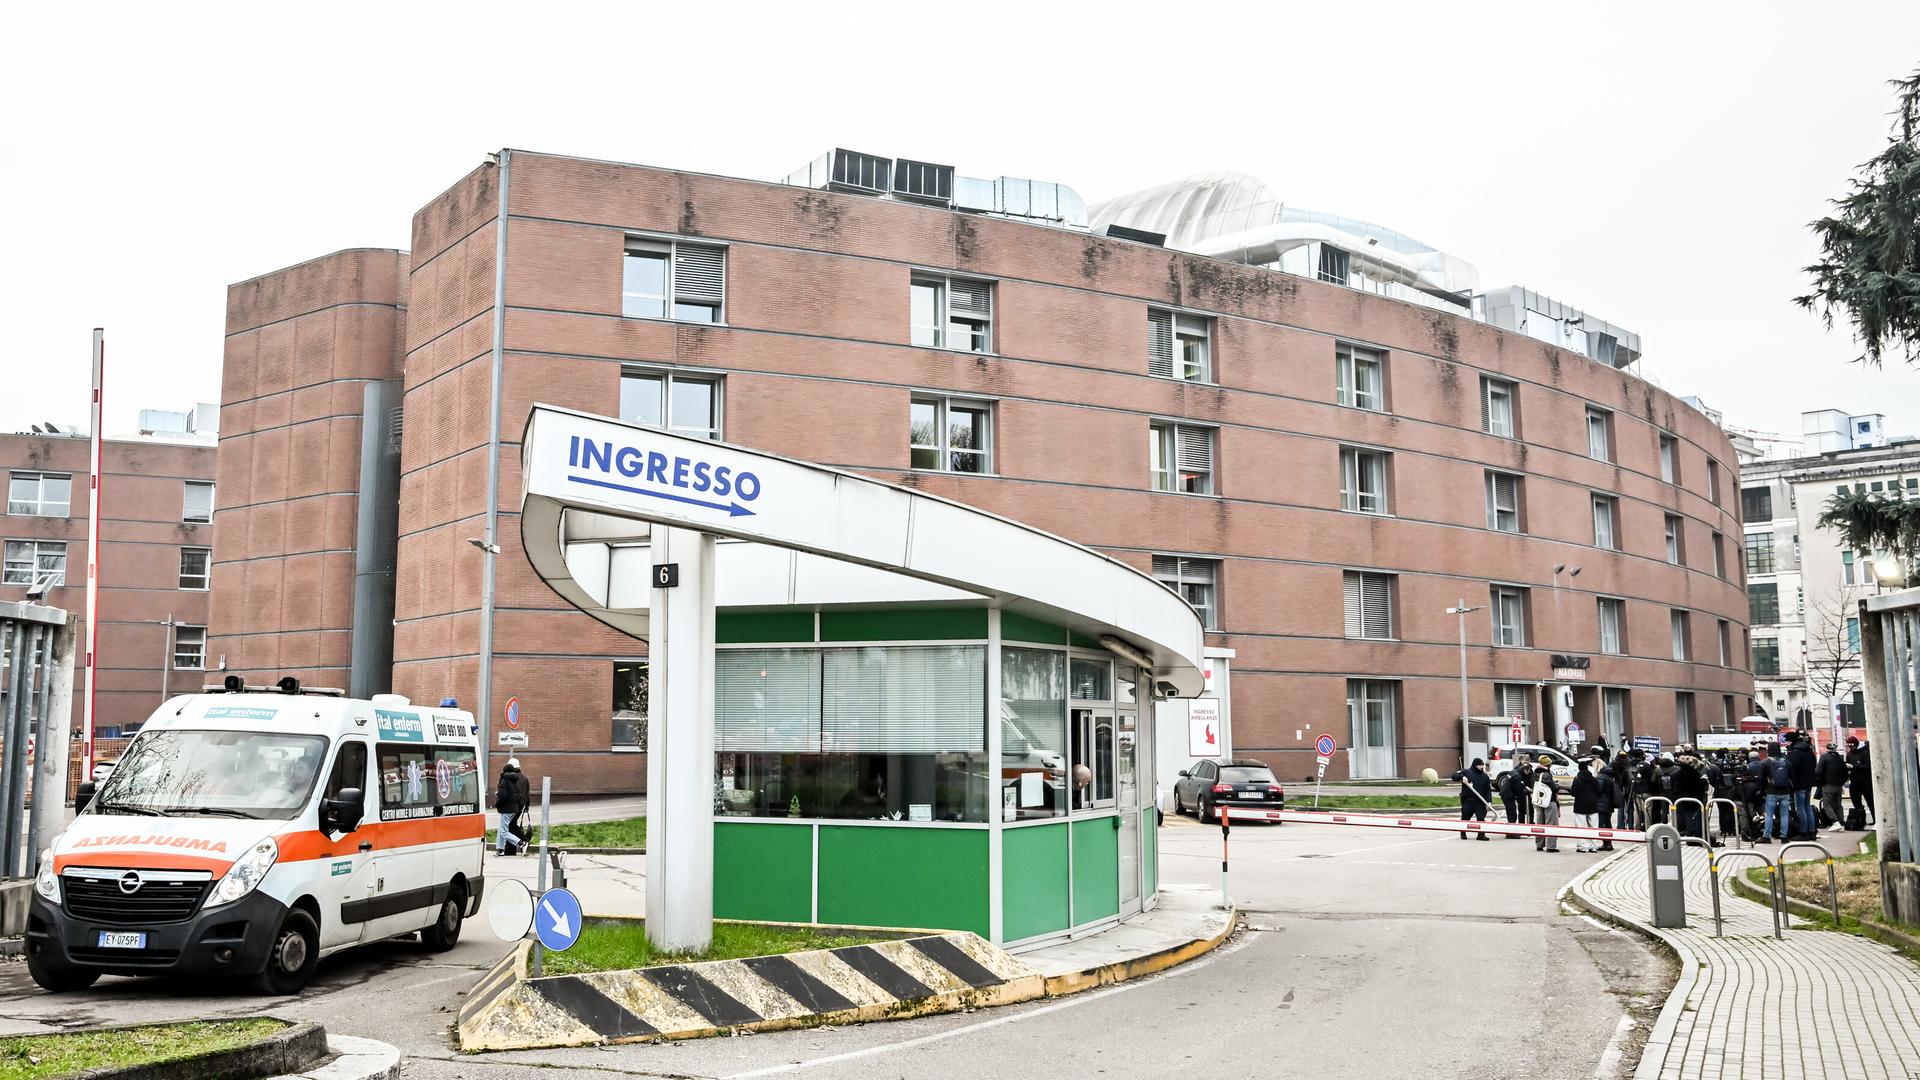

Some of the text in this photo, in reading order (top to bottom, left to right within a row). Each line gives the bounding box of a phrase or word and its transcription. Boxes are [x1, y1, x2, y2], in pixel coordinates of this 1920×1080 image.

[569, 435, 761, 501] INGRESSO
[659, 566, 669, 584] 6
[377, 713, 422, 732] ital enferm
[382, 809, 395, 820] CENTRO
[395, 808, 409, 819] MOBILE
